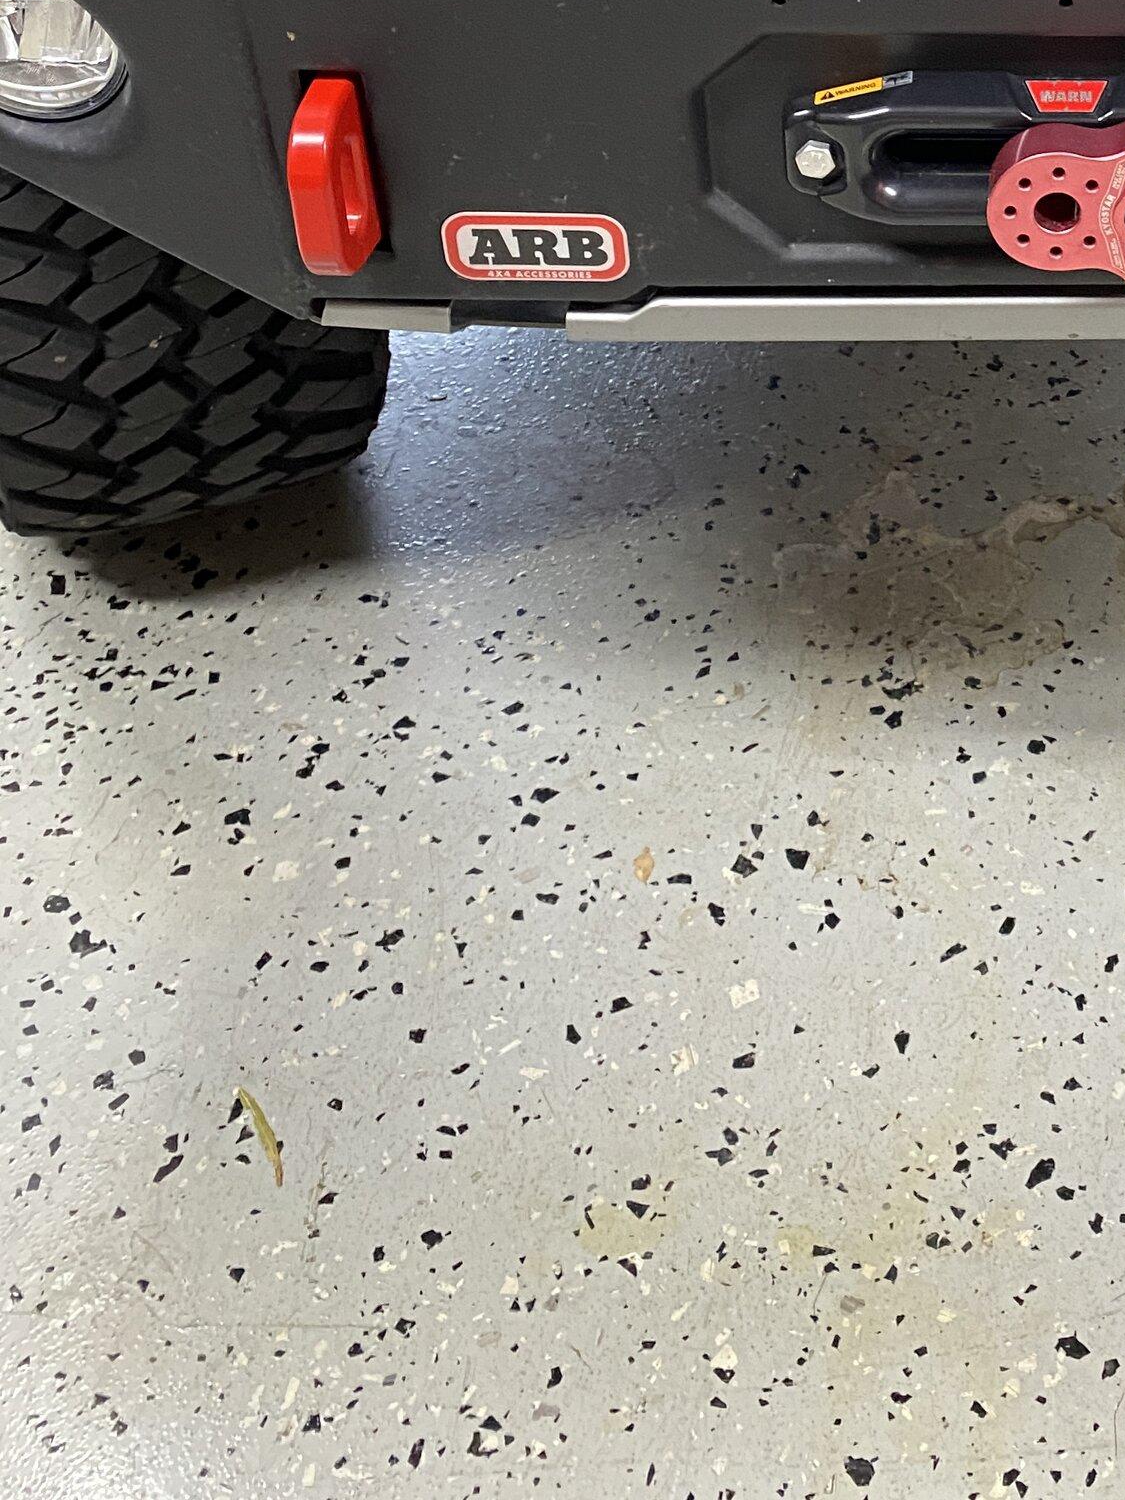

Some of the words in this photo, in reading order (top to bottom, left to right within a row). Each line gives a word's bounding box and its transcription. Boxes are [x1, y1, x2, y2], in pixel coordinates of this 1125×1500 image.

[834, 82, 876, 96] WARNING
[1040, 90, 1092, 103] WARN
[1100, 194, 1117, 236] KYOSTAR
[468, 228, 609, 266] ARB
[487, 270, 511, 278] 4X4
[515, 270, 593, 279] ACCESSORIES
